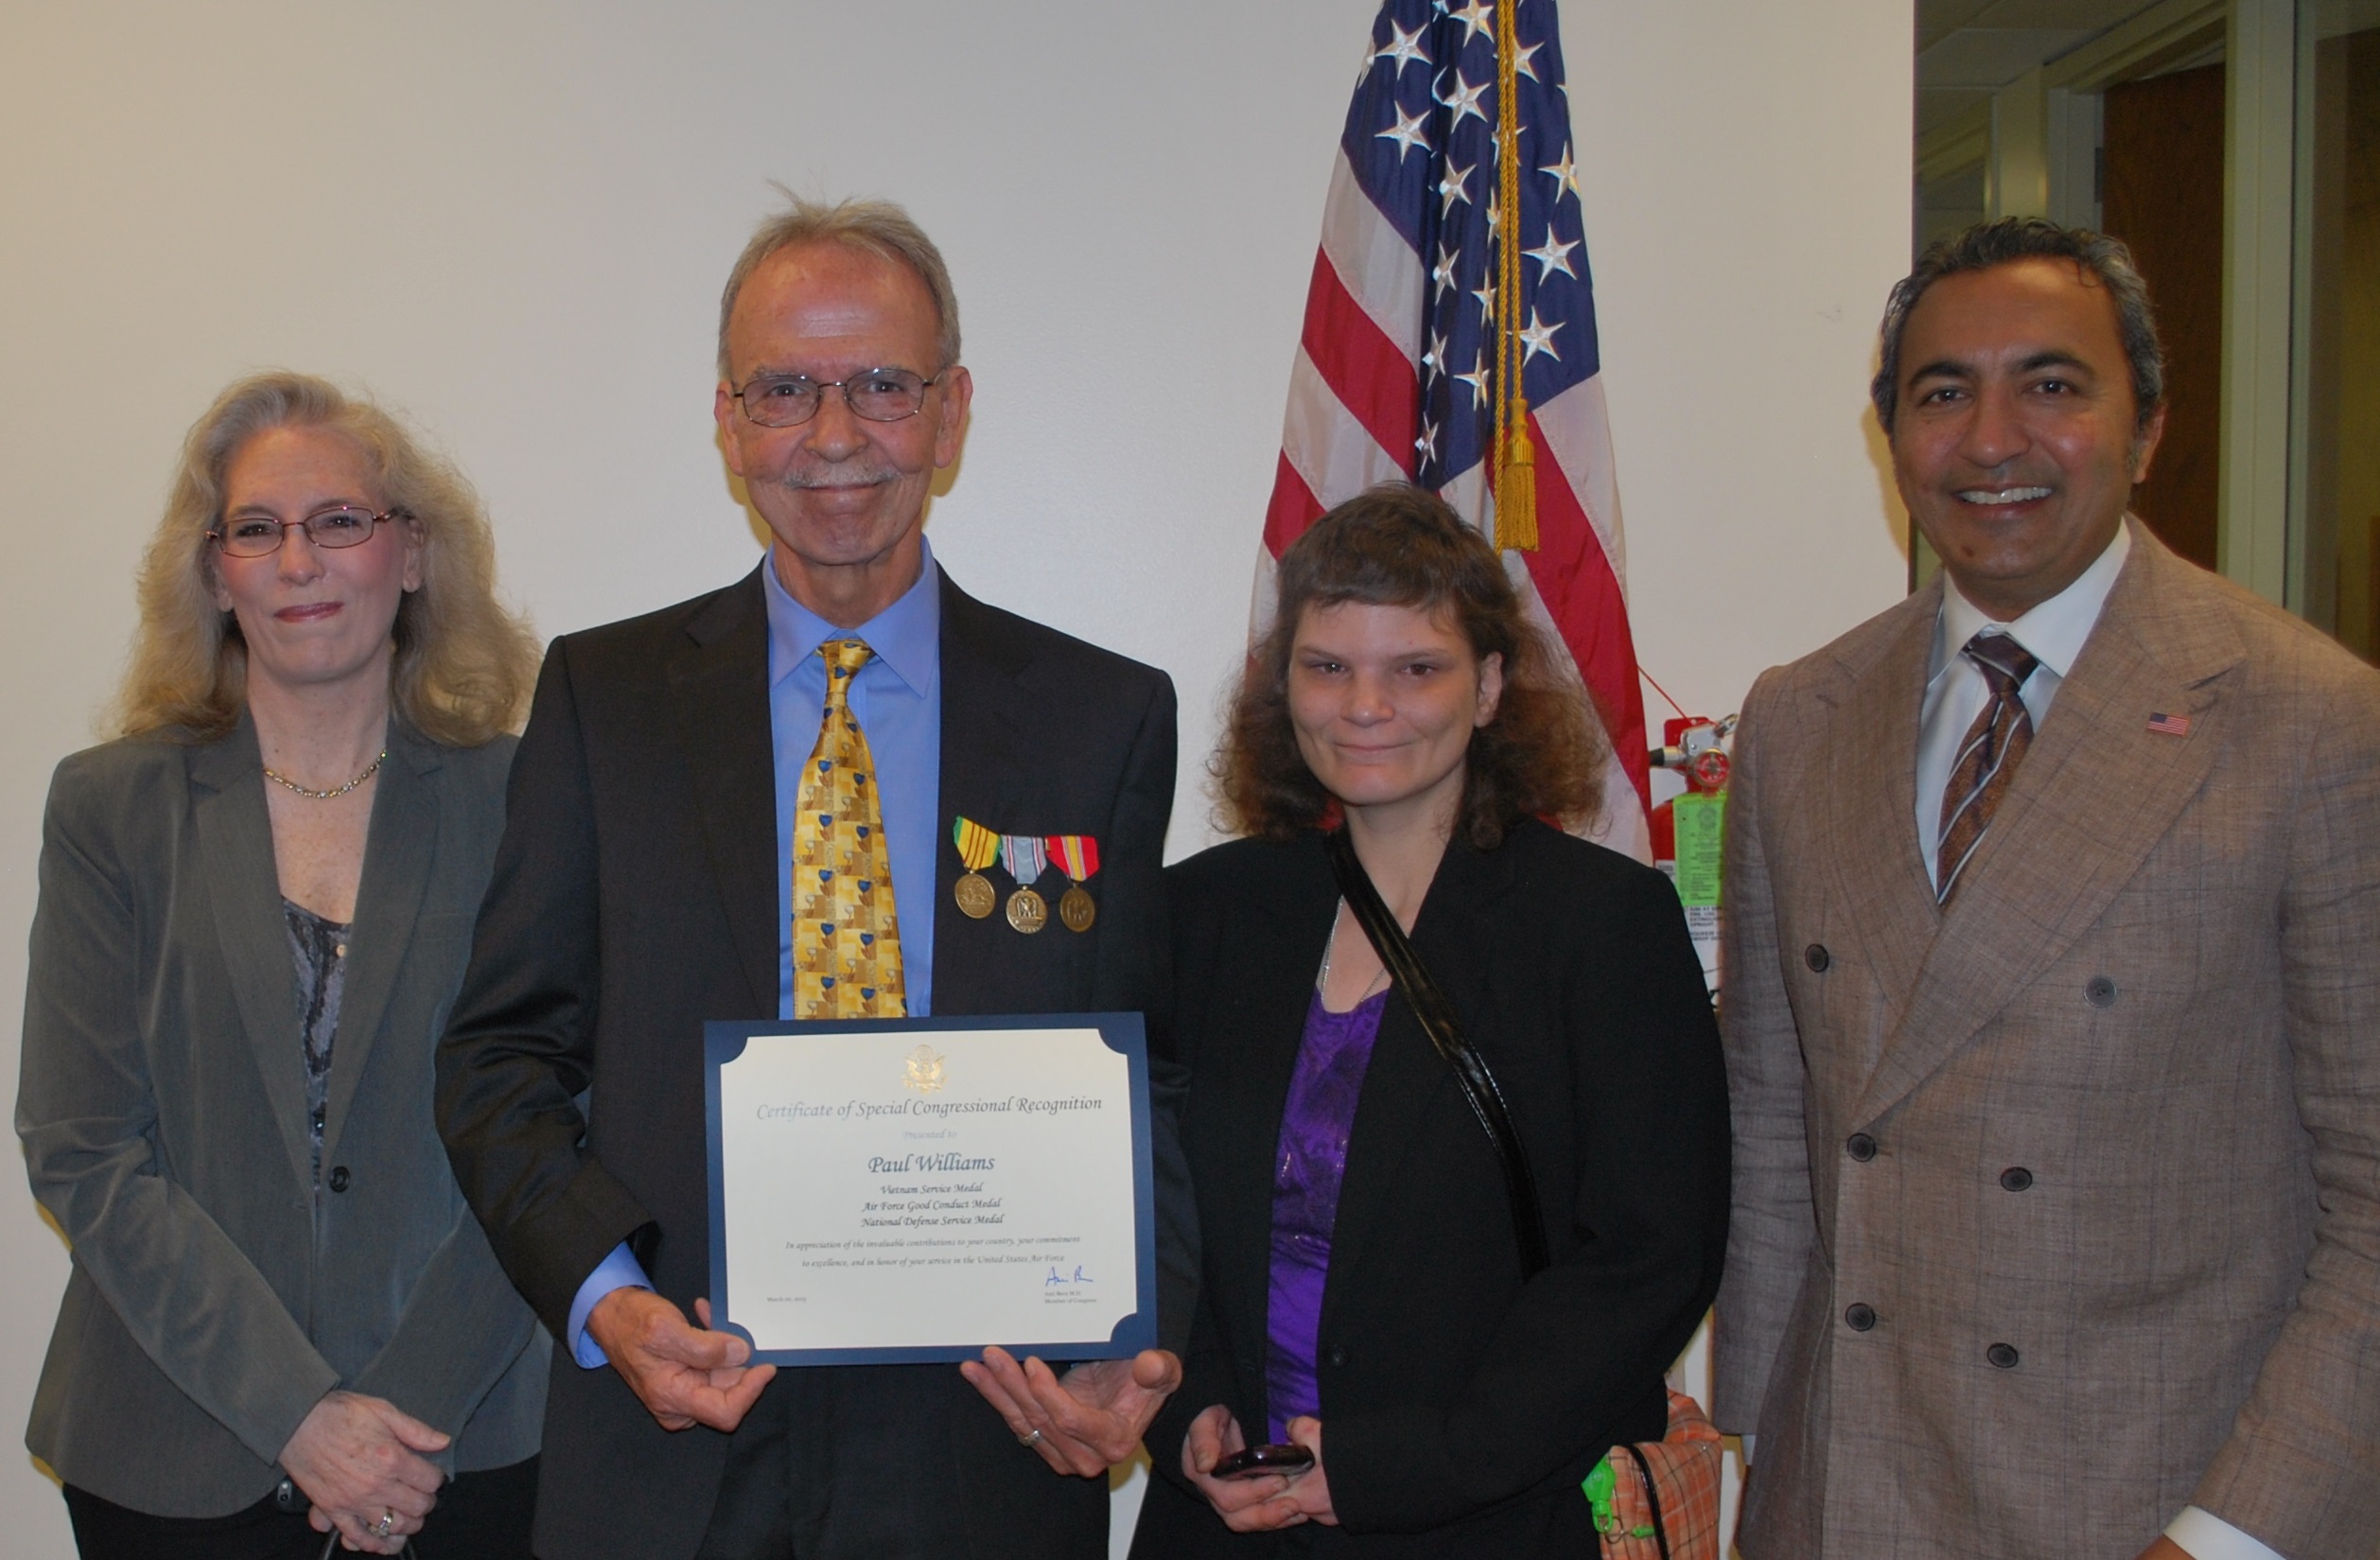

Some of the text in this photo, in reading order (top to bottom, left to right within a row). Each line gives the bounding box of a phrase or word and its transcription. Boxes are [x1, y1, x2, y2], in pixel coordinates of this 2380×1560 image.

[757, 1096, 1102, 1122] Certificate of Special Congressional Recognition
[902, 1128, 957, 1140] Presented to
[868, 1152, 995, 1173] Paul Williams
[881, 1183, 985, 1194] Vietnam Service Medal
[862, 1198, 1003, 1212] Air Force Good Conduct Medal
[861, 1214, 1005, 1229] National Defense Service Medal
[796, 1240, 841, 1252] appreciation
[843, 1239, 852, 1250] of
[852, 1239, 865, 1248] the
[866, 1238, 905, 1248] invaluable
[906, 1237, 955, 1247] contributions
[966, 1238, 984, 1248] your
[1017, 1237, 1034, 1247] your
[1035, 1236, 1080, 1244] commitment
[850, 1258, 866, 1267] and
[876, 1257, 897, 1266] honor
[899, 1256, 909, 1268] of
[909, 1258, 926, 1268] your
[963, 1255, 974, 1264] the
[976, 1254, 1005, 1264] United
[1004, 1254, 1028, 1264] States
[1028, 1254, 1042, 1263] Air
